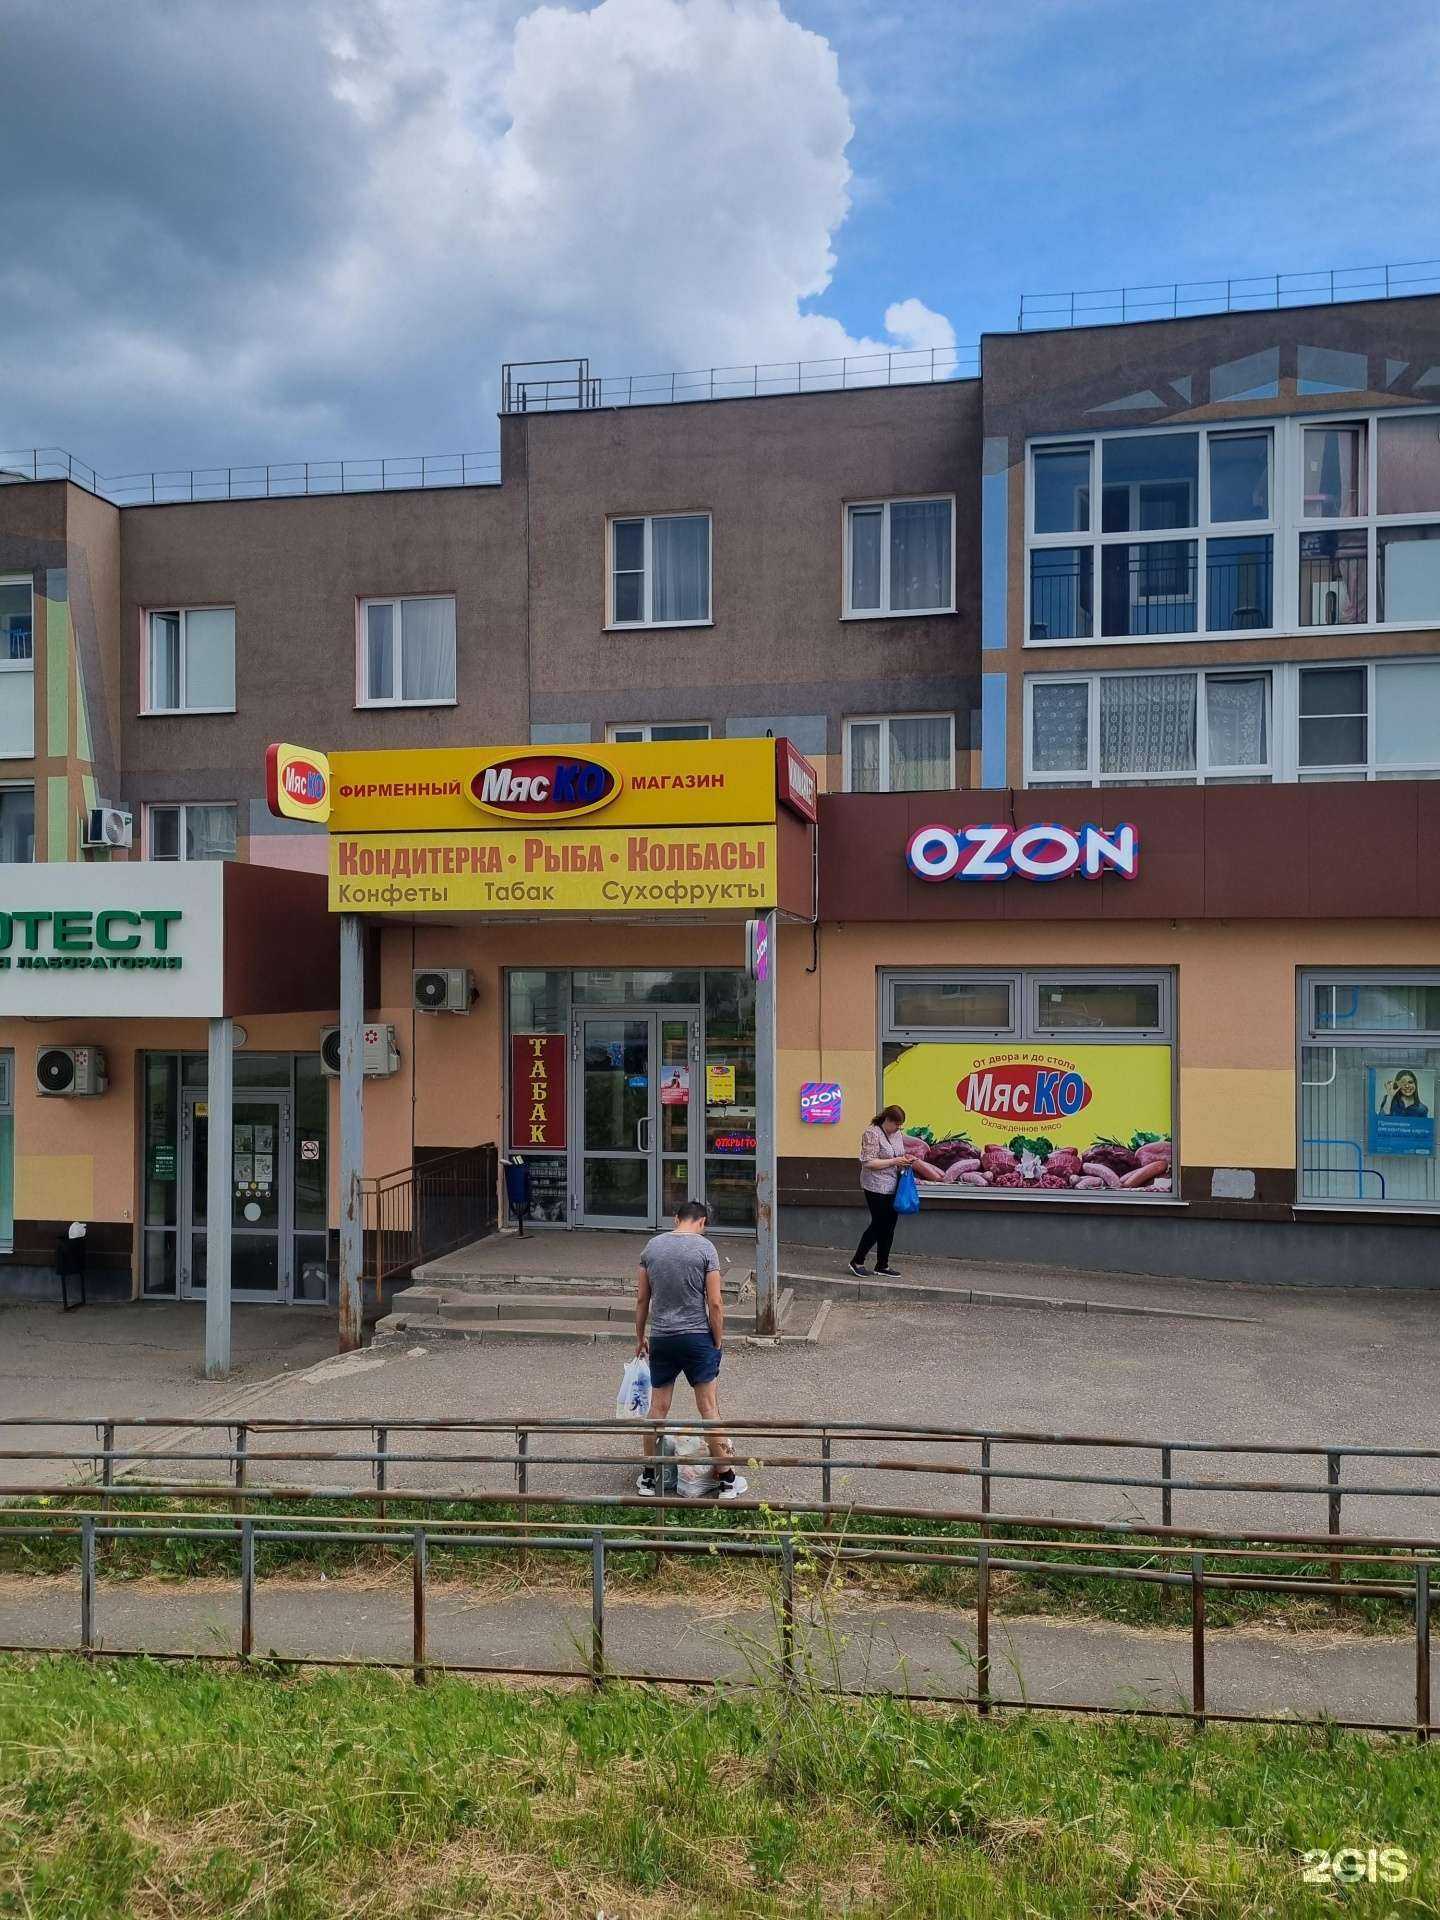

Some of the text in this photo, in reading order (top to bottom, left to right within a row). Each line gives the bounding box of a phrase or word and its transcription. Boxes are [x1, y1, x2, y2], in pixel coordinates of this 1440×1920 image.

[339, 779, 461, 798] ФИРМЕННЫЙ
[631, 774, 724, 790] МАГАЗИН
[911, 827, 1133, 876] OZON
[339, 880, 765, 906] Конфеты Табак Сухофрукты
[16, 956, 182, 969] ЛАБОРАТОРИЯ
[973, 1059, 986, 1069] От
[989, 1054, 1019, 1065] двора
[1032, 1054, 1044, 1063] до
[1047, 1055, 1076, 1071] стола
[528, 1039, 547, 1142] ТАБАК
[801, 1090, 841, 1107] OZON
[1040, 1122, 1062, 1131] мясо
[715, 1136, 757, 1148] ОТКРЫТО
